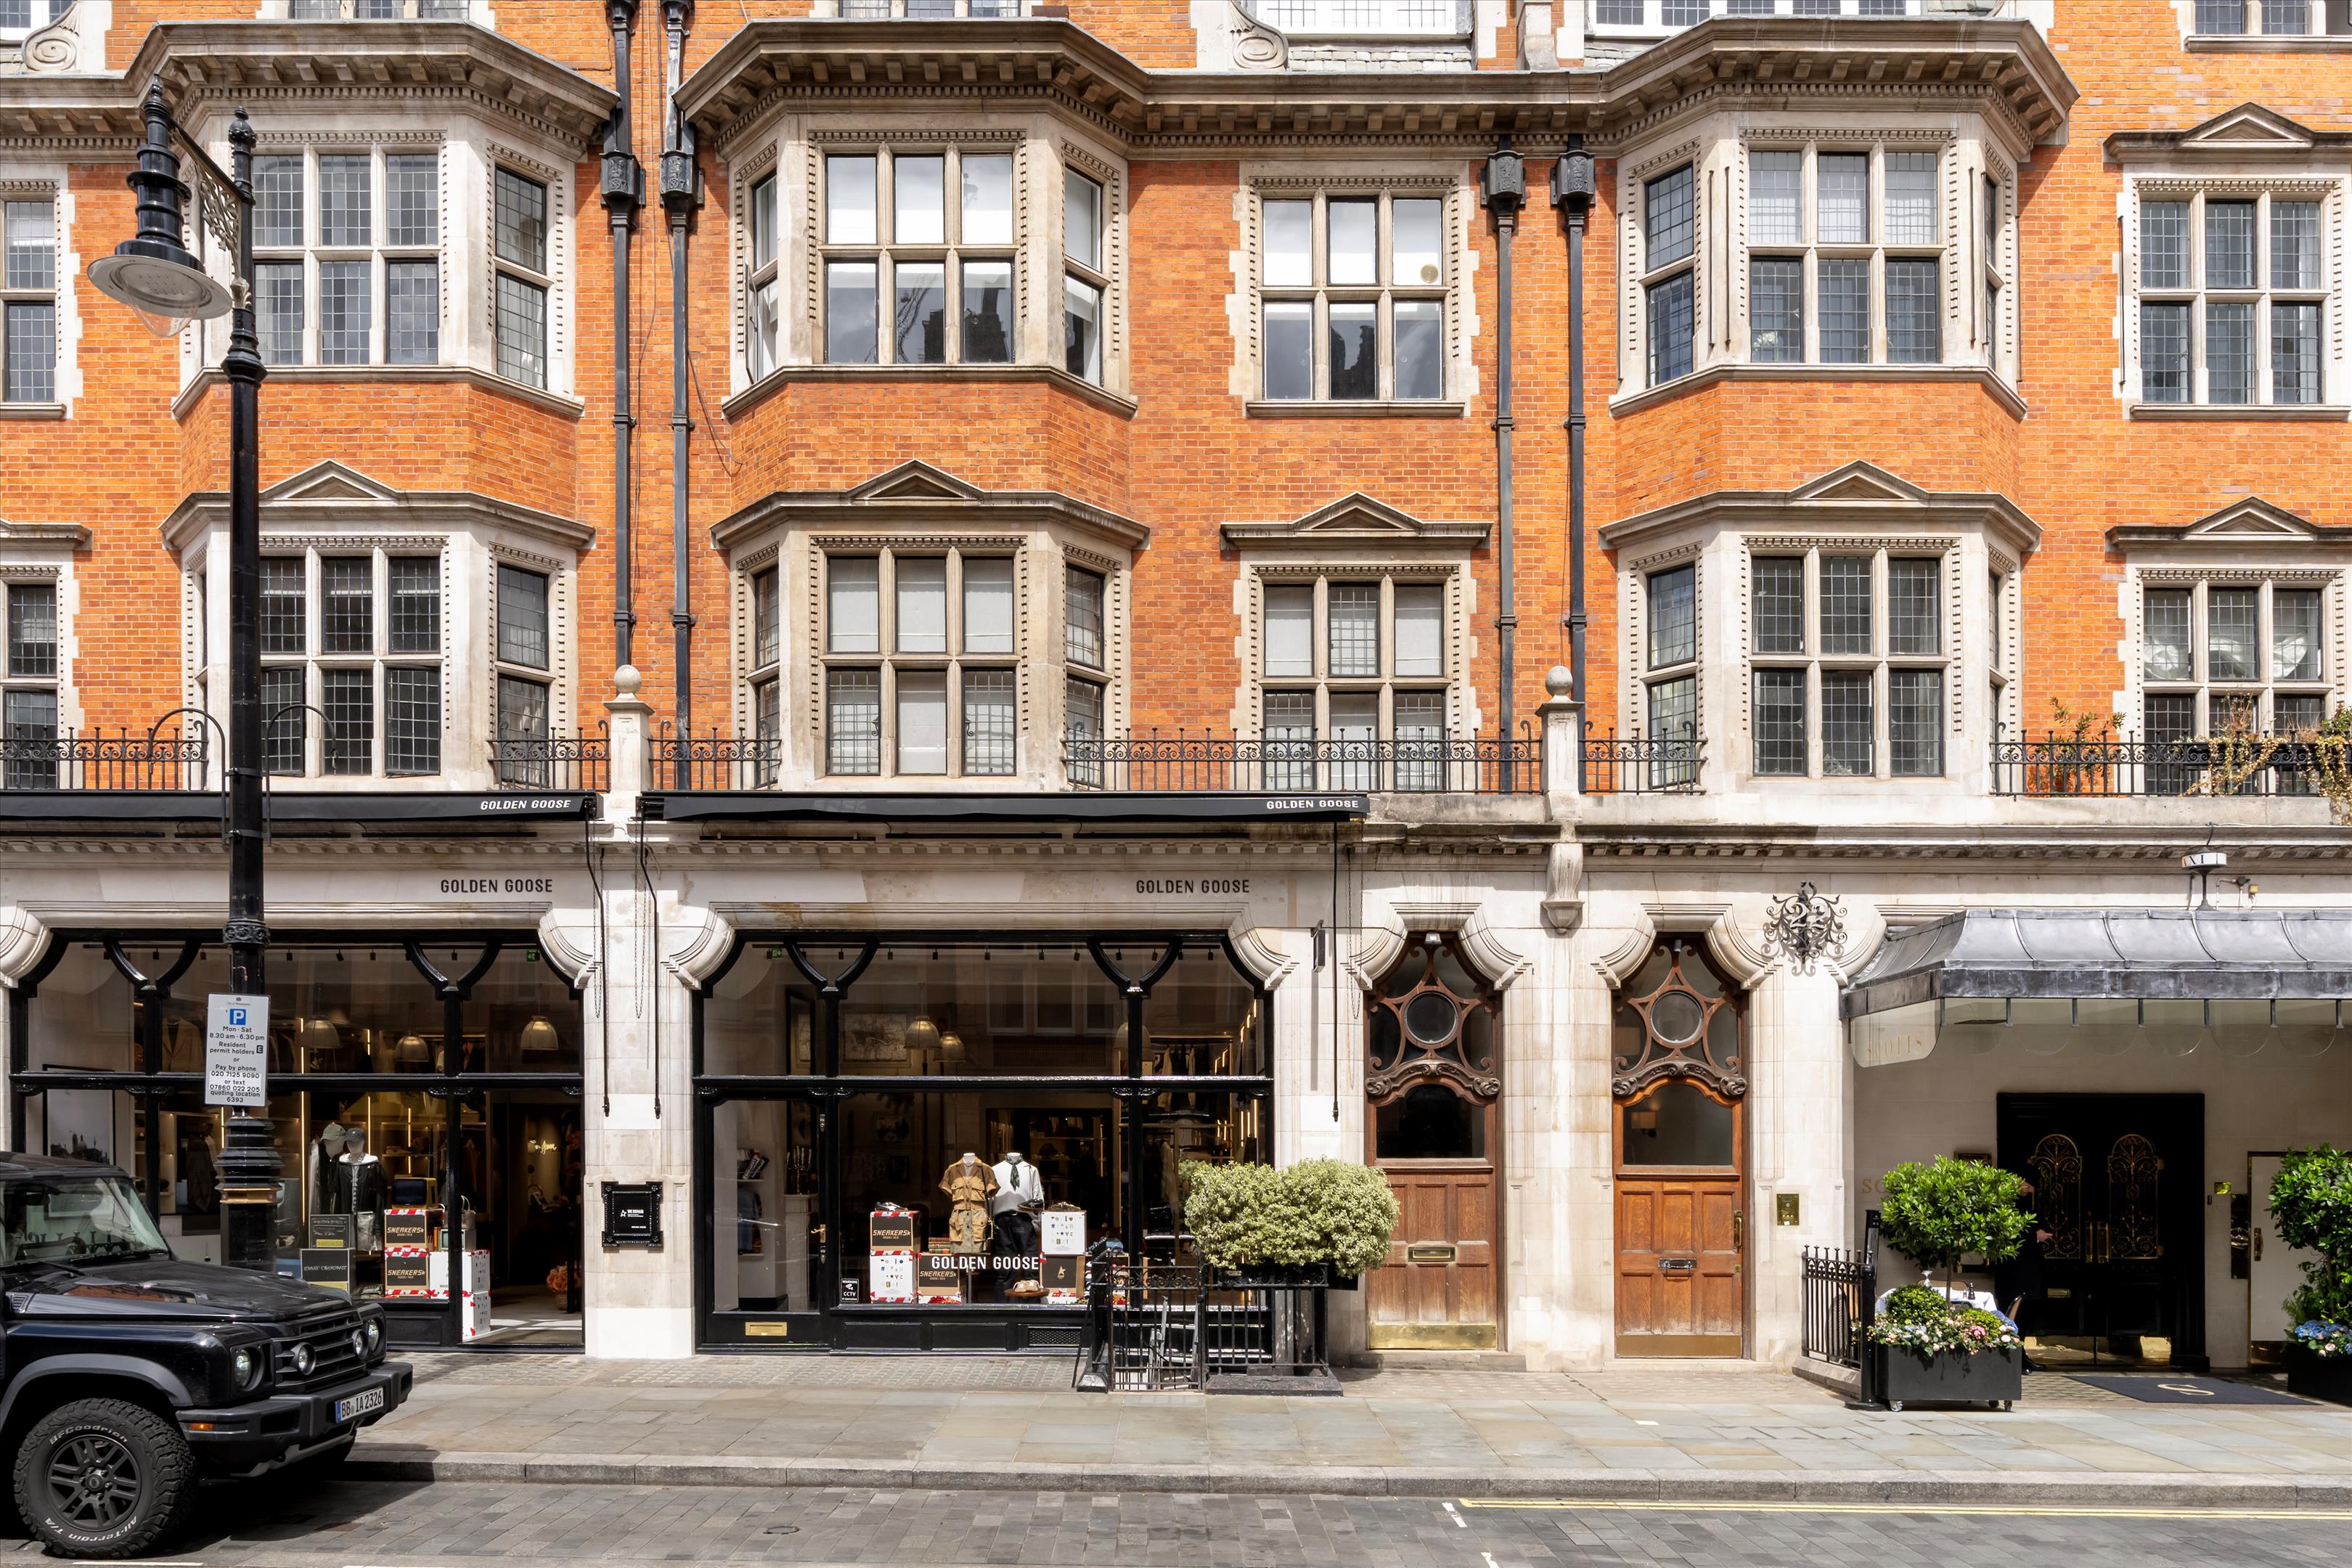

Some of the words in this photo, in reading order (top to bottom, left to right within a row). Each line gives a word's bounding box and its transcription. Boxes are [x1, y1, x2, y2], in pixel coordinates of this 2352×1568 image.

[481, 800, 527, 810] GOLDEN
[531, 800, 571, 809] GOOSE
[1266, 800, 1314, 809] GOLDEN
[441, 879, 498, 893] GOLDEN
[505, 879, 552, 893] GOOSE
[1136, 880, 1193, 894] GOLDEN
[1201, 880, 1249, 893] GOOSE
[1790, 902, 1829, 930] 22
[234, 1010, 244, 1024] P
[931, 1256, 986, 1269] GOLDEN
[993, 1257, 1039, 1270] GOOSE
[341, 1401, 351, 1418] BB
[356, 1397, 363, 1413] IA
[365, 1390, 382, 1409] 2326
[49, 1425, 128, 1445] BFGoodrich
[45, 1517, 64, 1535] T/A
[68, 1516, 137, 1542] All-Terrain
